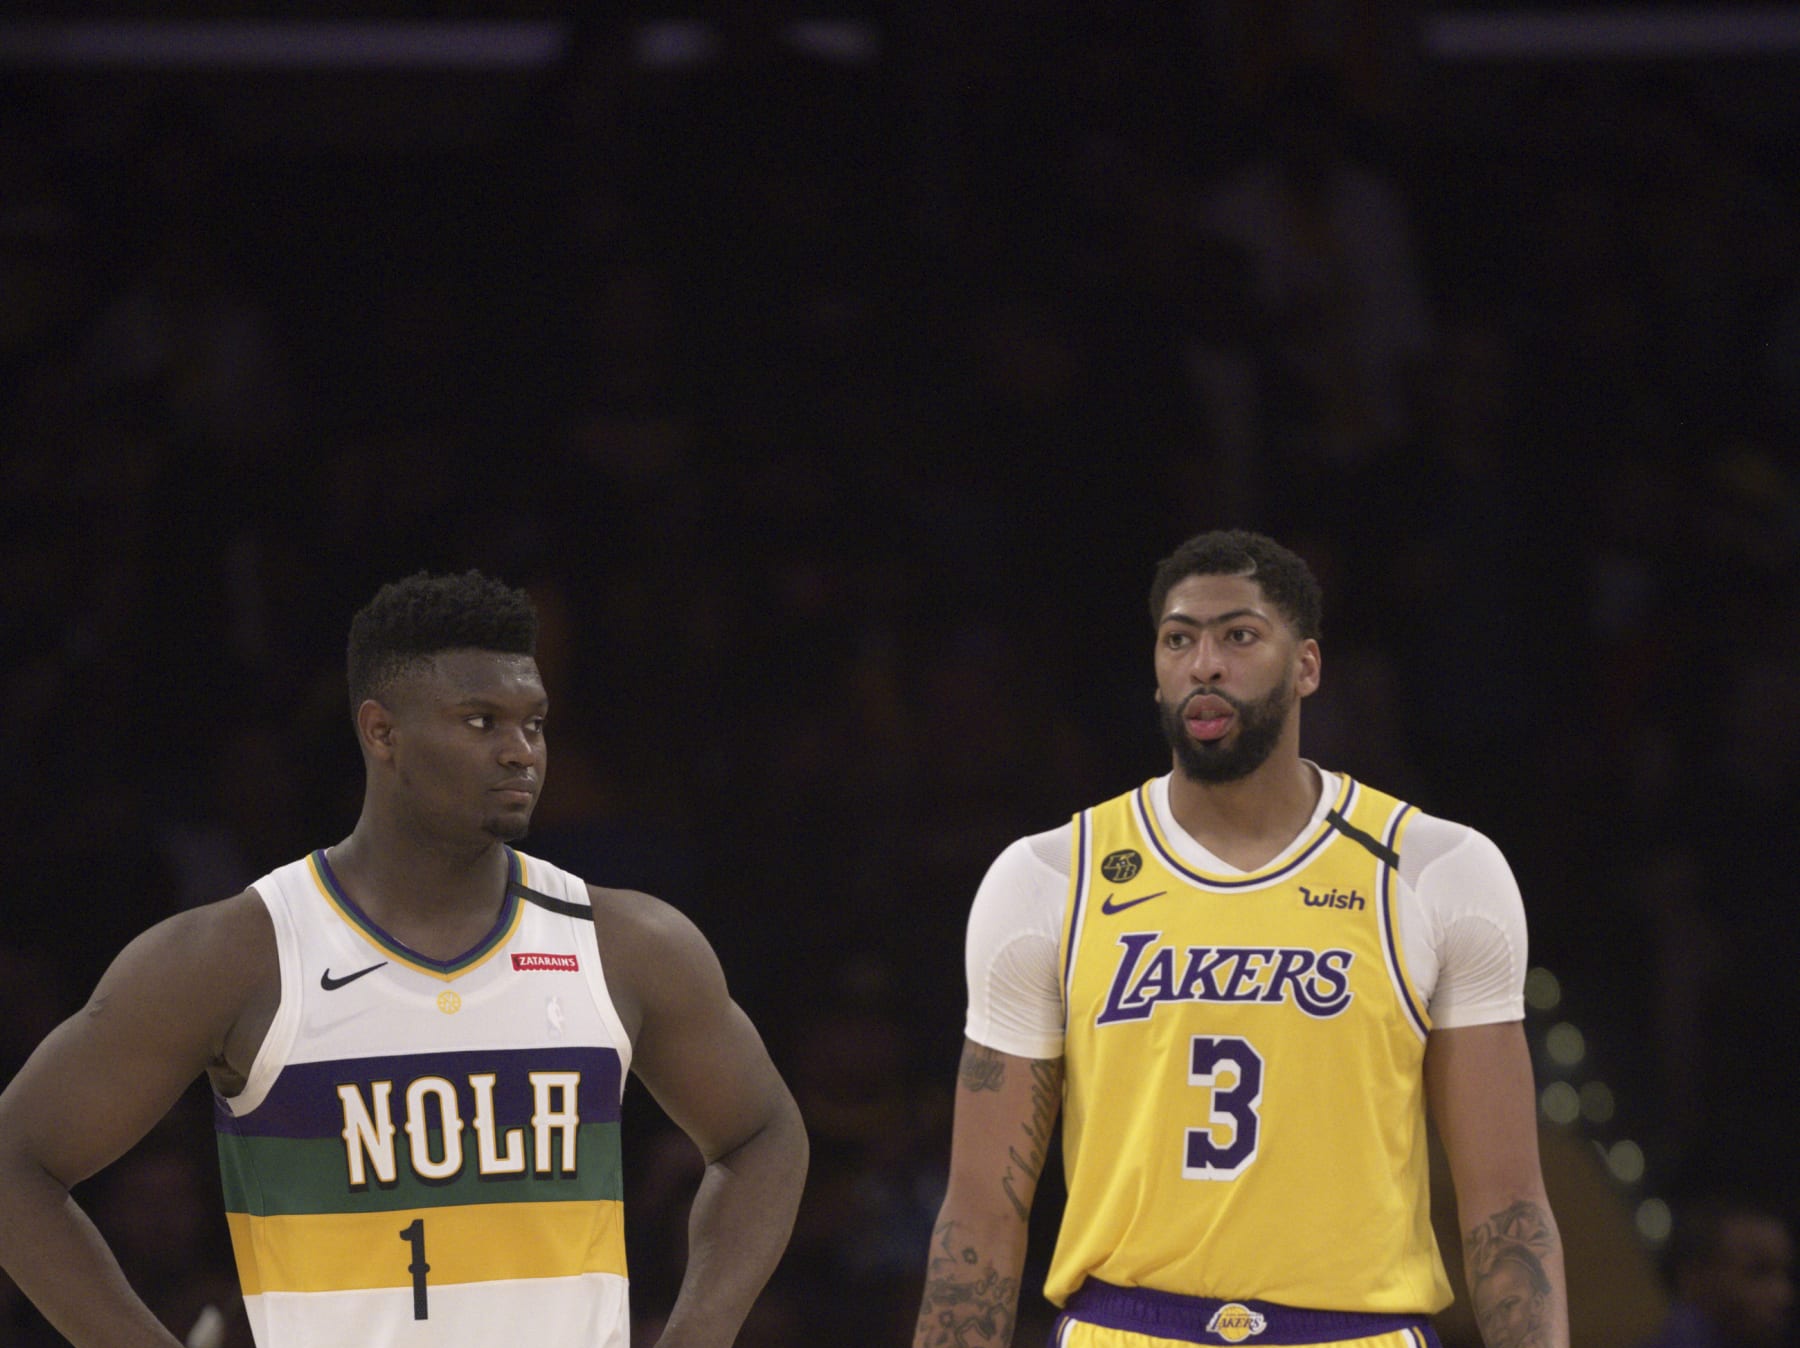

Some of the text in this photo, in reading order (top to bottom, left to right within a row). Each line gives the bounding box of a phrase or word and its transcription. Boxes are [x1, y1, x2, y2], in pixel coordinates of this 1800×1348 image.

[1298, 886, 1365, 911] wish
[1095, 931, 1355, 1026] LAKERS
[336, 1070, 583, 1191] NOLA
[1182, 1034, 1264, 1181] 3
[399, 1218, 431, 1321] 1
